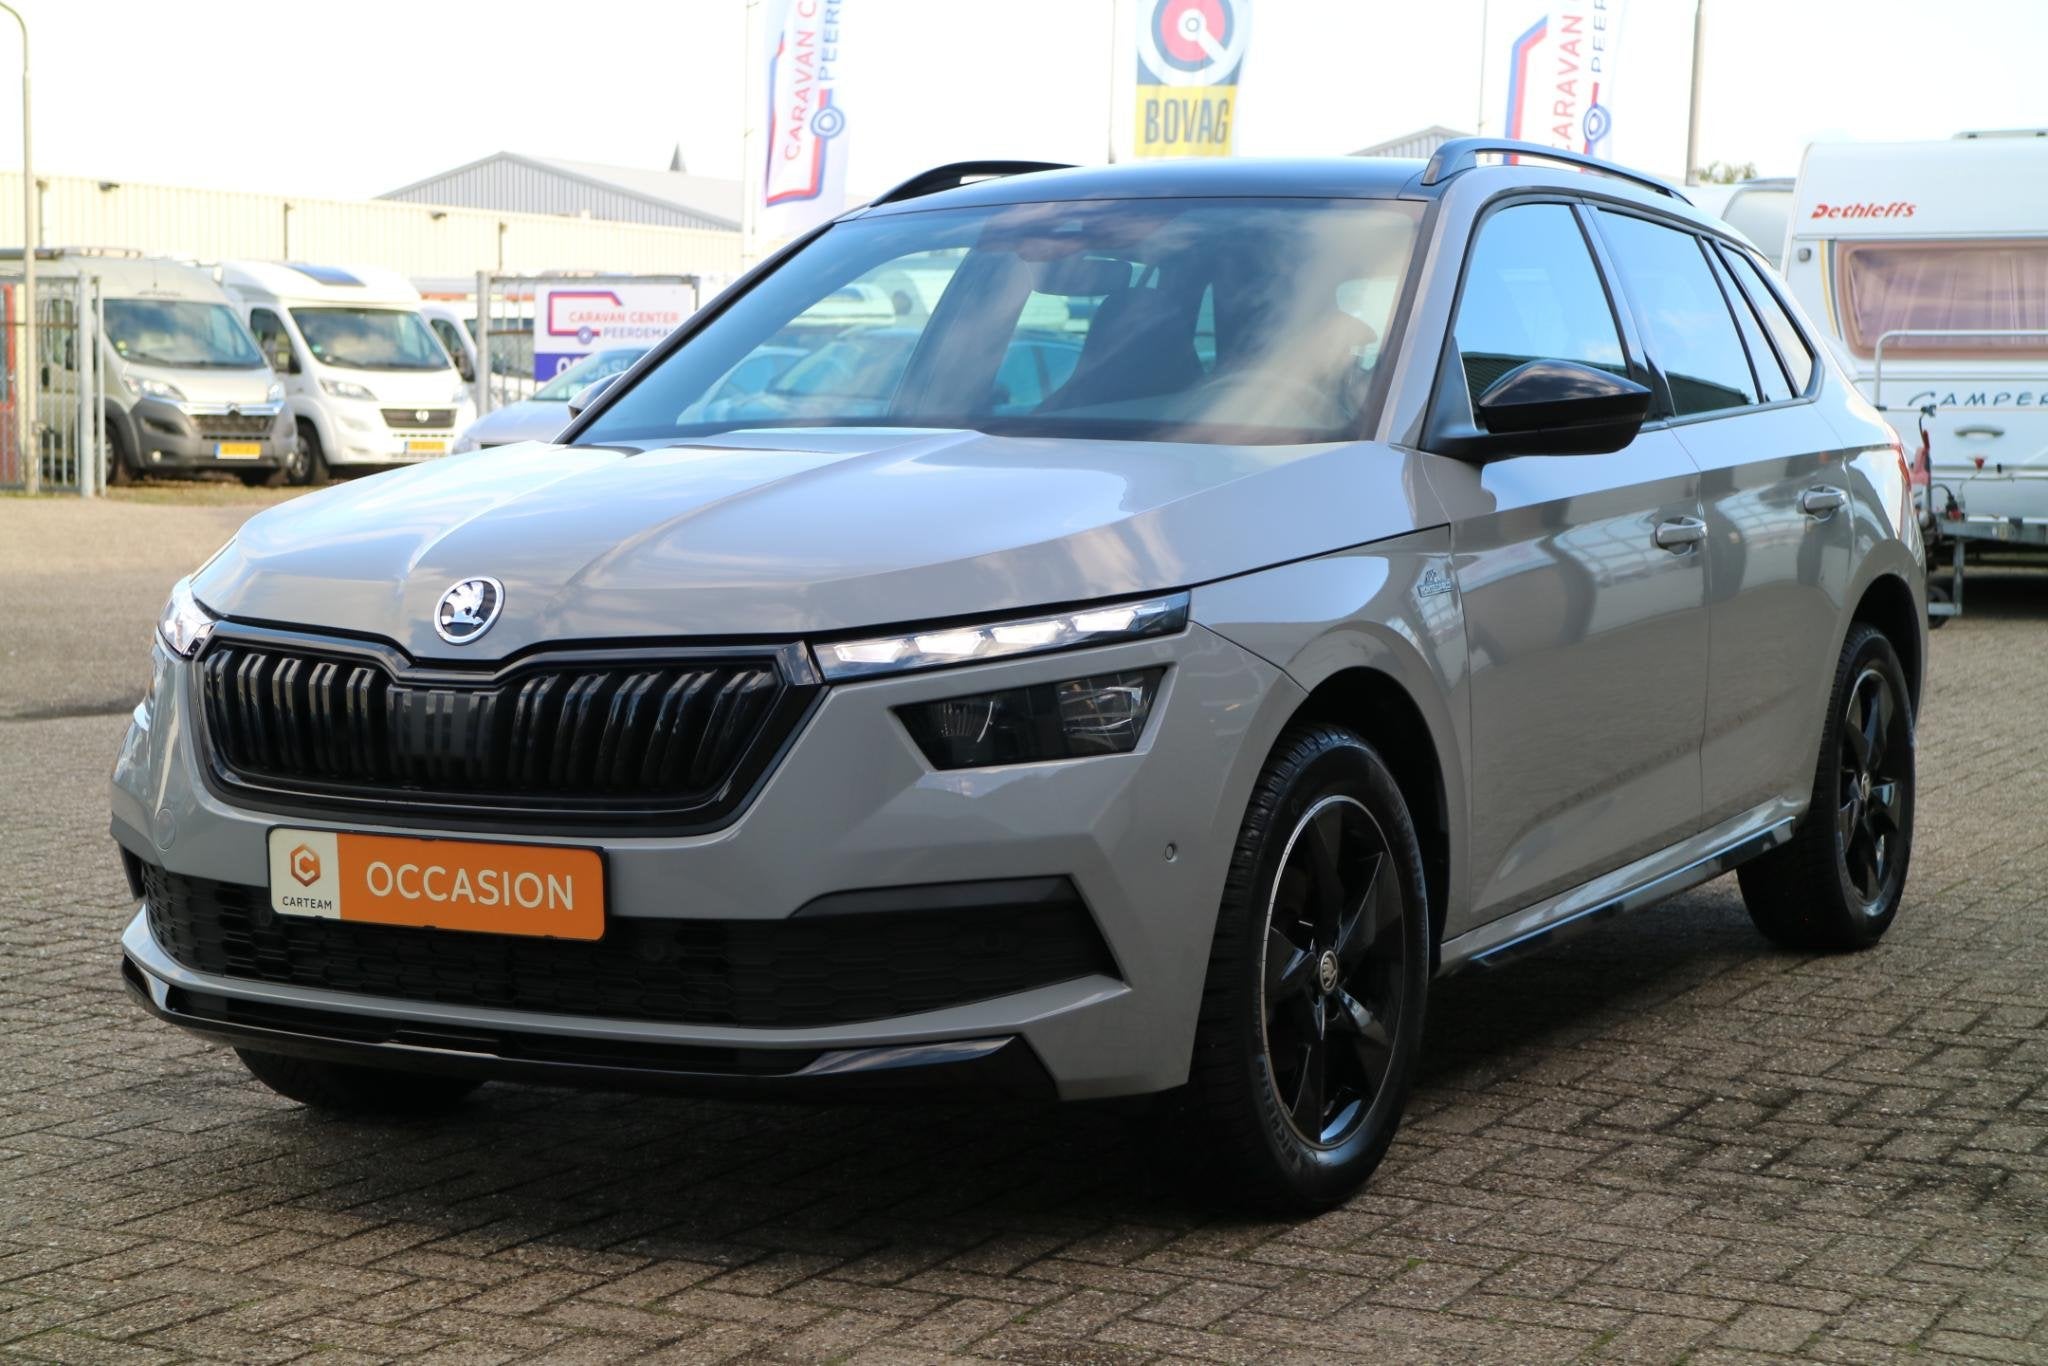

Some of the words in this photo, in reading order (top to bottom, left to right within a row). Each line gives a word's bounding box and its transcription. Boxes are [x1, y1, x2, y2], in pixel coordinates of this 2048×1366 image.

[818, 0, 841, 81] PEER
[784, 31, 816, 160] CARAVAN
[1552, 15, 1584, 150] ARAVAN
[1144, 98, 1230, 144] BOVAG
[1811, 202, 1916, 218] Dethleffs
[568, 311, 625, 323] CARAVAN
[628, 311, 680, 324] CENTER
[282, 895, 333, 911] CARTEAM
[366, 861, 575, 911] OCCASION
